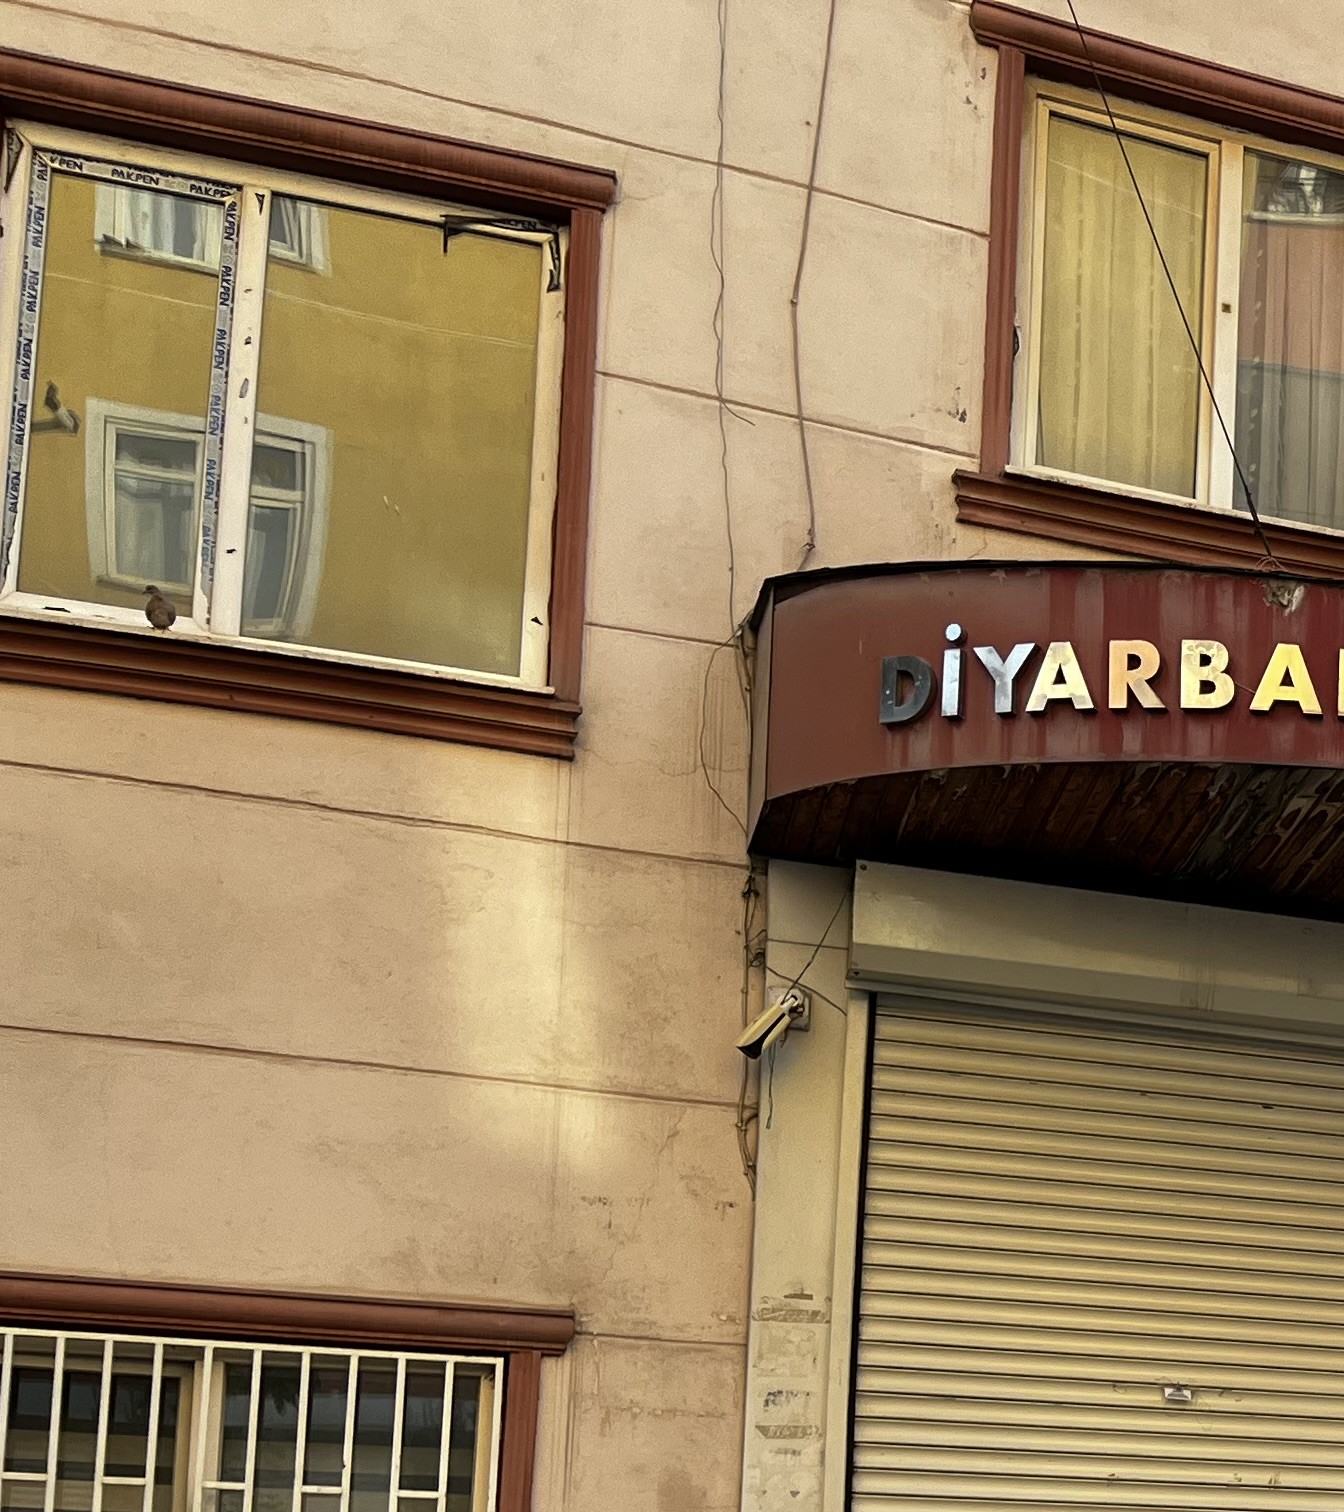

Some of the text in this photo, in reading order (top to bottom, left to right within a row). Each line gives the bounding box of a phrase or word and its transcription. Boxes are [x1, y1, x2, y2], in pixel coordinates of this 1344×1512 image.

[111, 168, 159, 186] PAKPEN
[32, 205, 45, 249] PAKPEN
[26, 270, 39, 313] PAKPEN
[219, 265, 232, 307] PAKPEN
[20, 338, 33, 380] PAKPEN
[213, 328, 227, 370] PAKPEN
[15, 403, 28, 446] PAKPEN
[208, 395, 221, 436] PAKPEN
[9, 471, 21, 514] PAKPEN
[204, 458, 217, 501] PAKPEN
